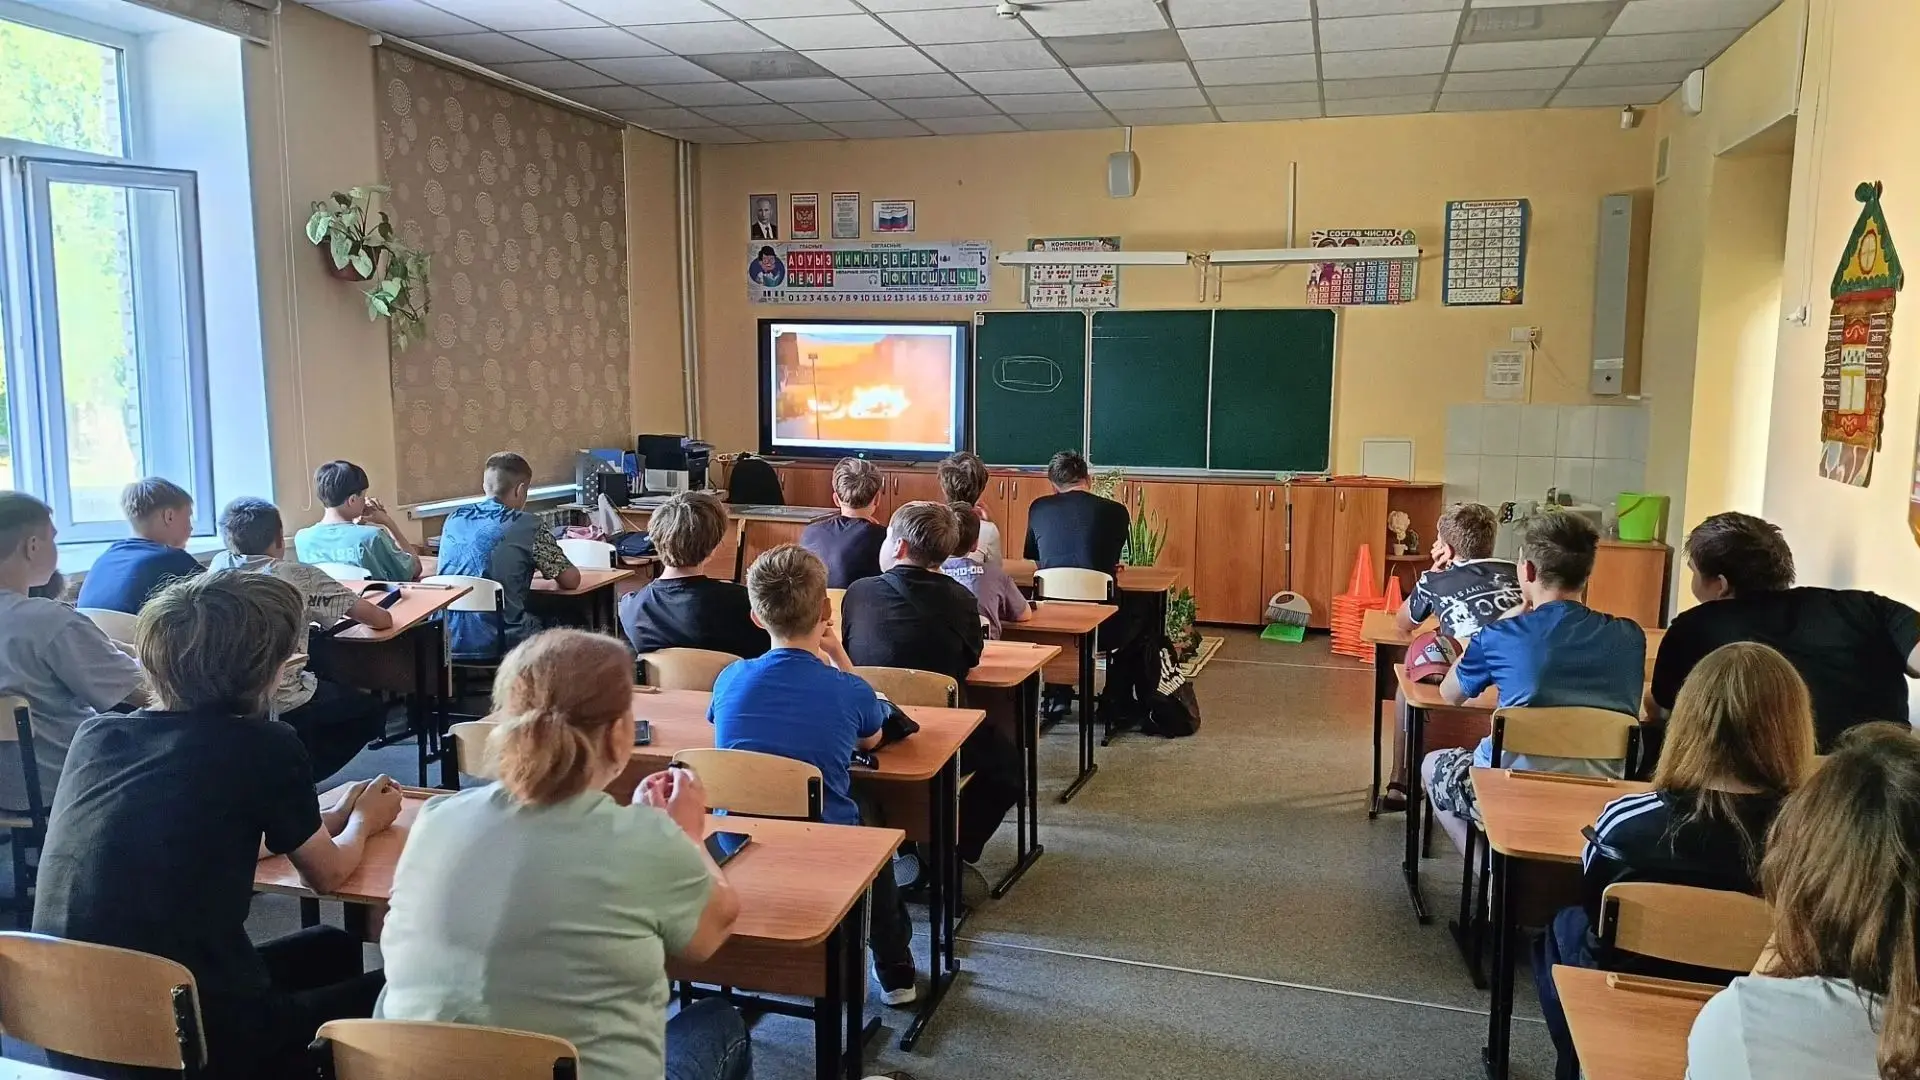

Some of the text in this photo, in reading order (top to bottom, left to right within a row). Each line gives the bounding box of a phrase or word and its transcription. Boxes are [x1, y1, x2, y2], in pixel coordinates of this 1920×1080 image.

[861, 294, 870, 302] 10
[872, 294, 880, 302] 11
[883, 294, 892, 302] 12
[894, 294, 903, 302] 13
[906, 294, 916, 302] 14
[918, 294, 928, 302] 15
[930, 294, 939, 302] 16
[942, 294, 950, 302] 17
[953, 294, 962, 302] 18
[965, 294, 974, 302] 19
[977, 294, 988, 302] 20
